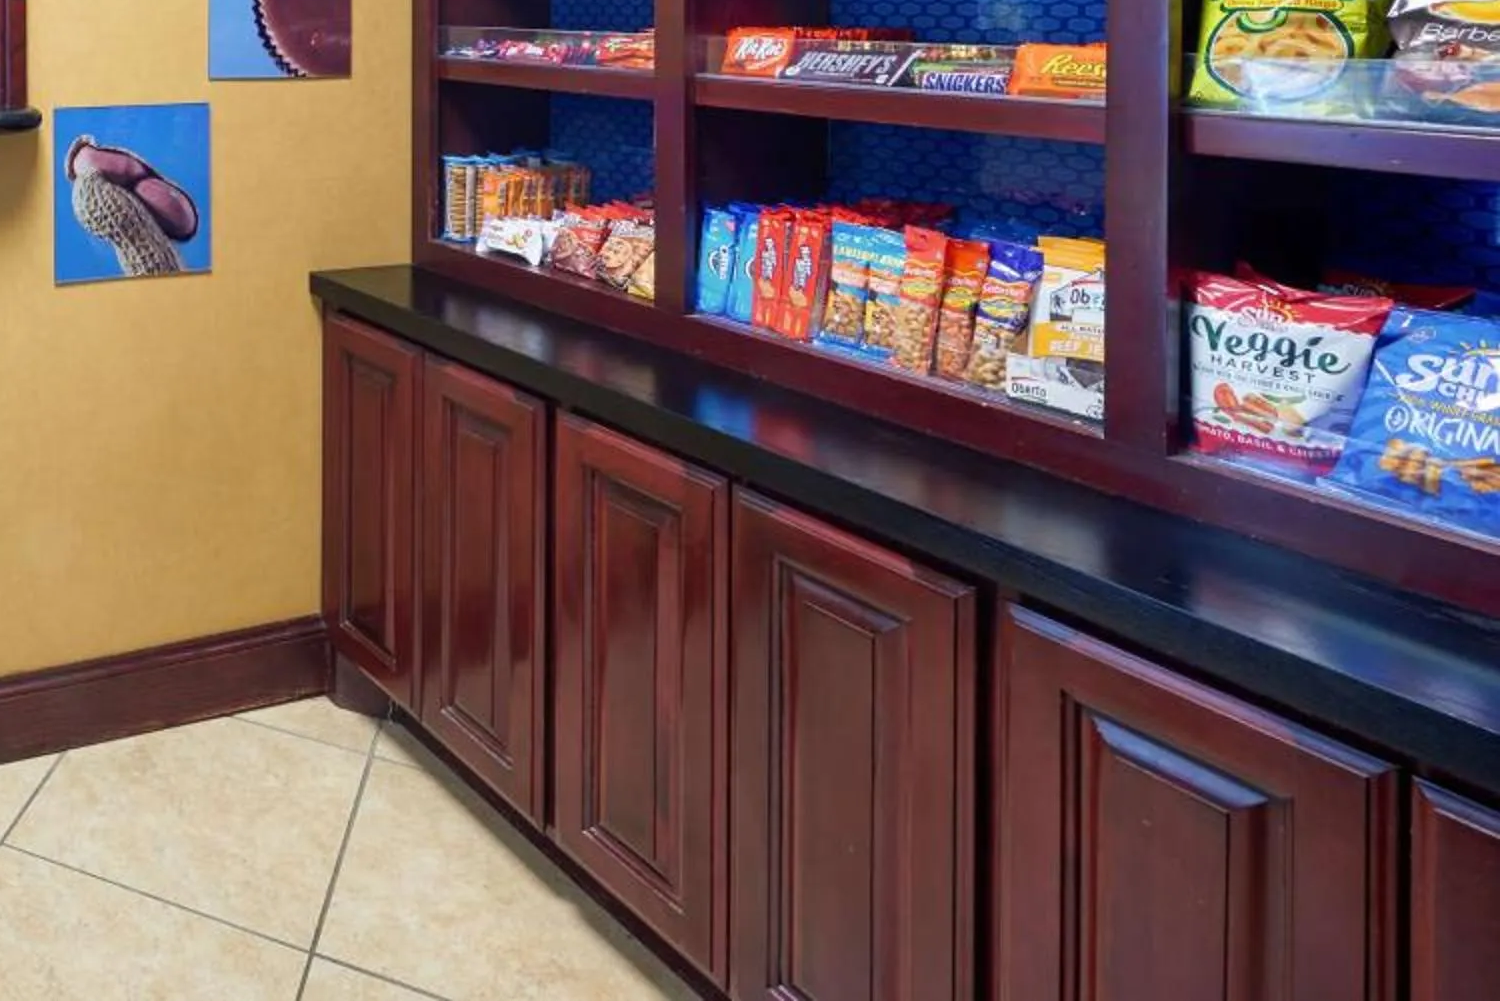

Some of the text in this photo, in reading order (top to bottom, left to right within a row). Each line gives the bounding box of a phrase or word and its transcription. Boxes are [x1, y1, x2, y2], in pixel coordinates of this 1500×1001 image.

[1418, 23, 1500, 42] Barbe
[923, 72, 1006, 94] SNICKERS
[1191, 314, 1351, 374] Veggie
[1211, 354, 1316, 384] HARVEST
[1385, 405, 1500, 455] ORIGINA
